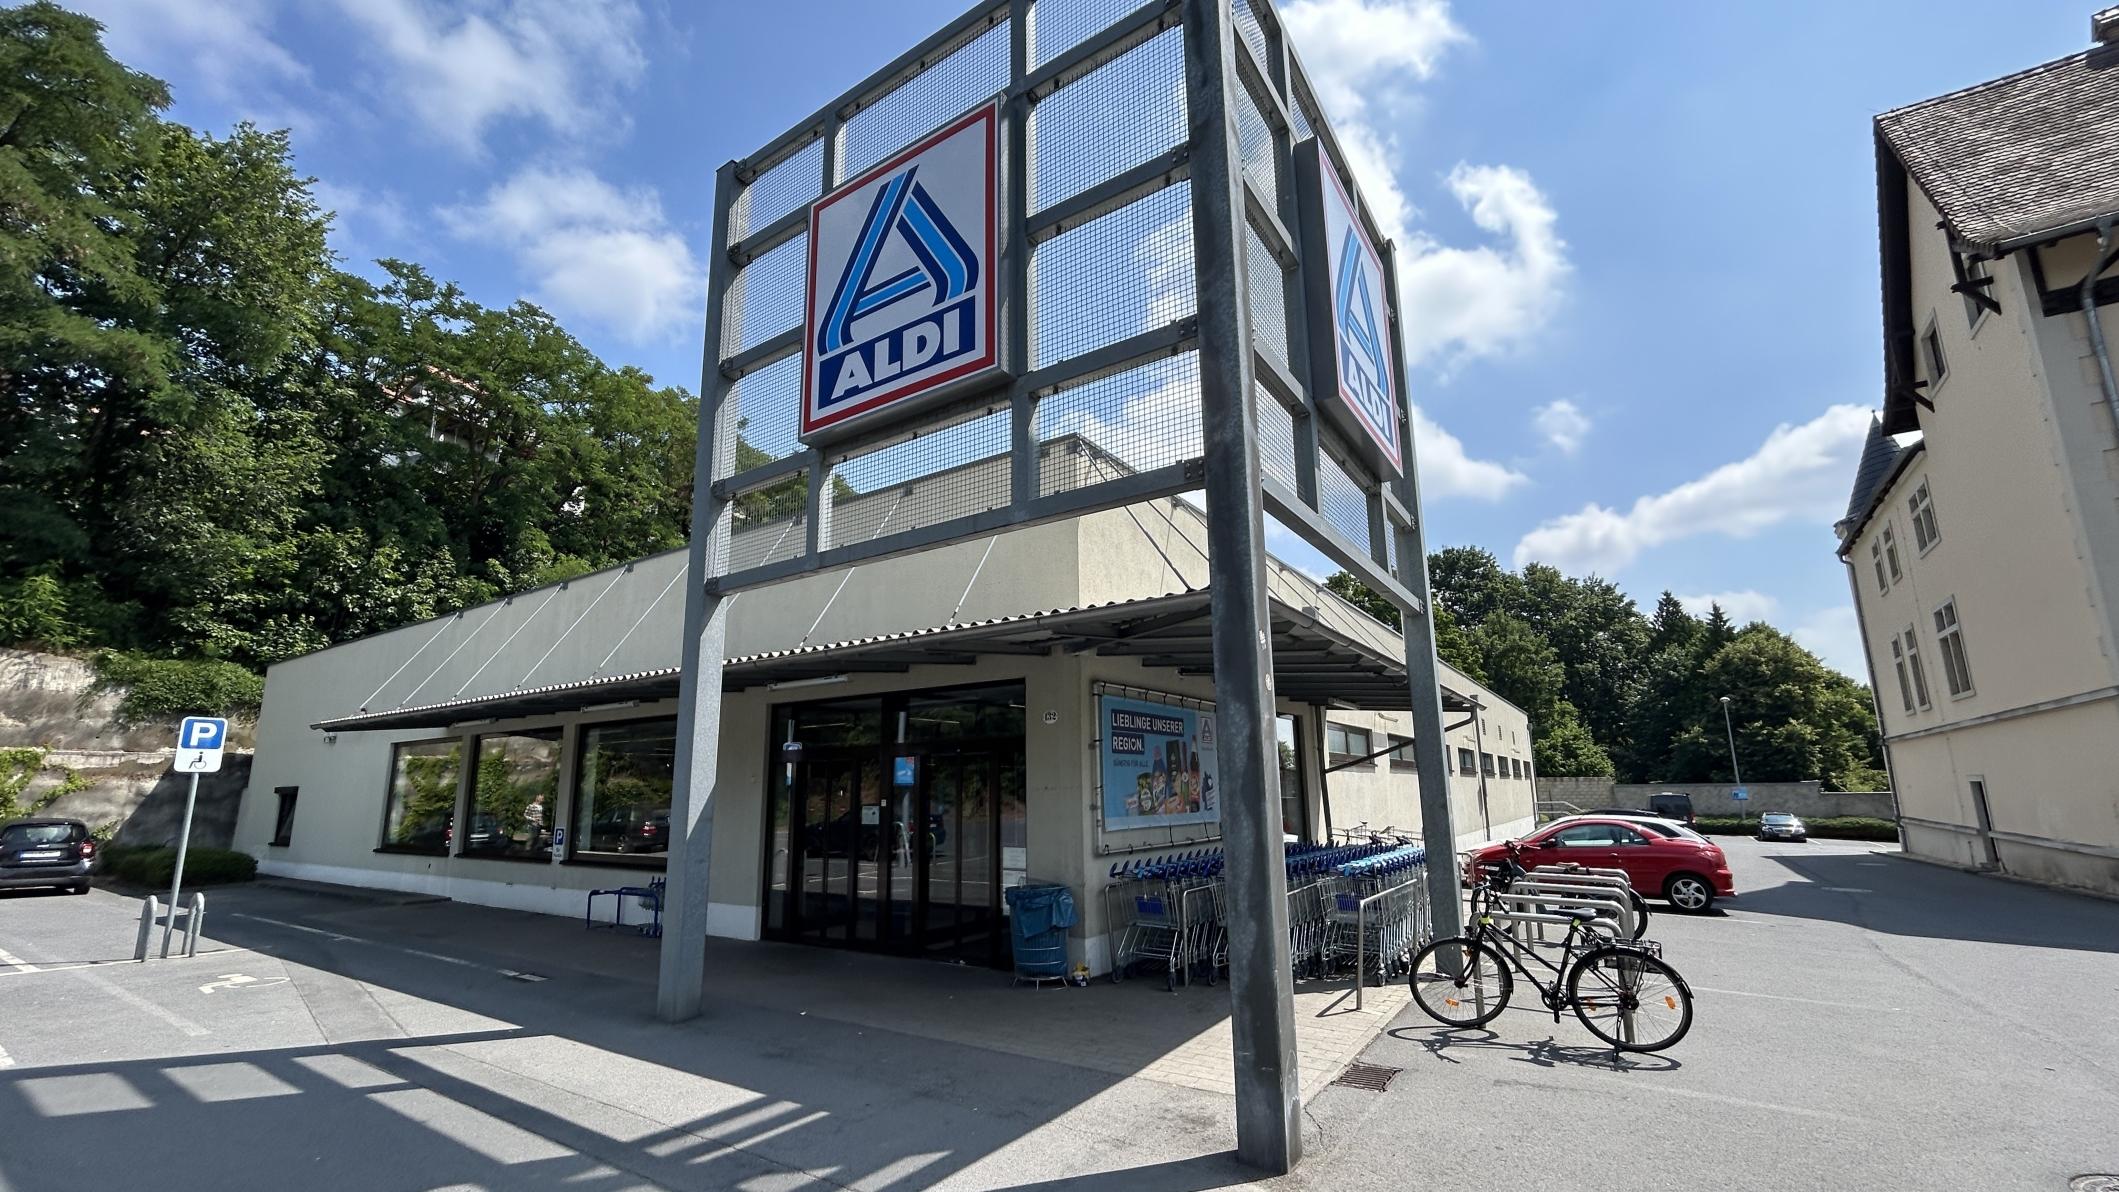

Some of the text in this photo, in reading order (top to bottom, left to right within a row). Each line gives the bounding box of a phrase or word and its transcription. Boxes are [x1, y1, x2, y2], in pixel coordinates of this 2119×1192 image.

[831, 308, 960, 399] ALDI
[1348, 353, 1390, 439] ALDI
[190, 722, 217, 746] P
[1112, 713, 1184, 734] LIEBLINGE UNSERER
[1112, 736, 1144, 751] REGION.
[556, 830, 563, 844] P
